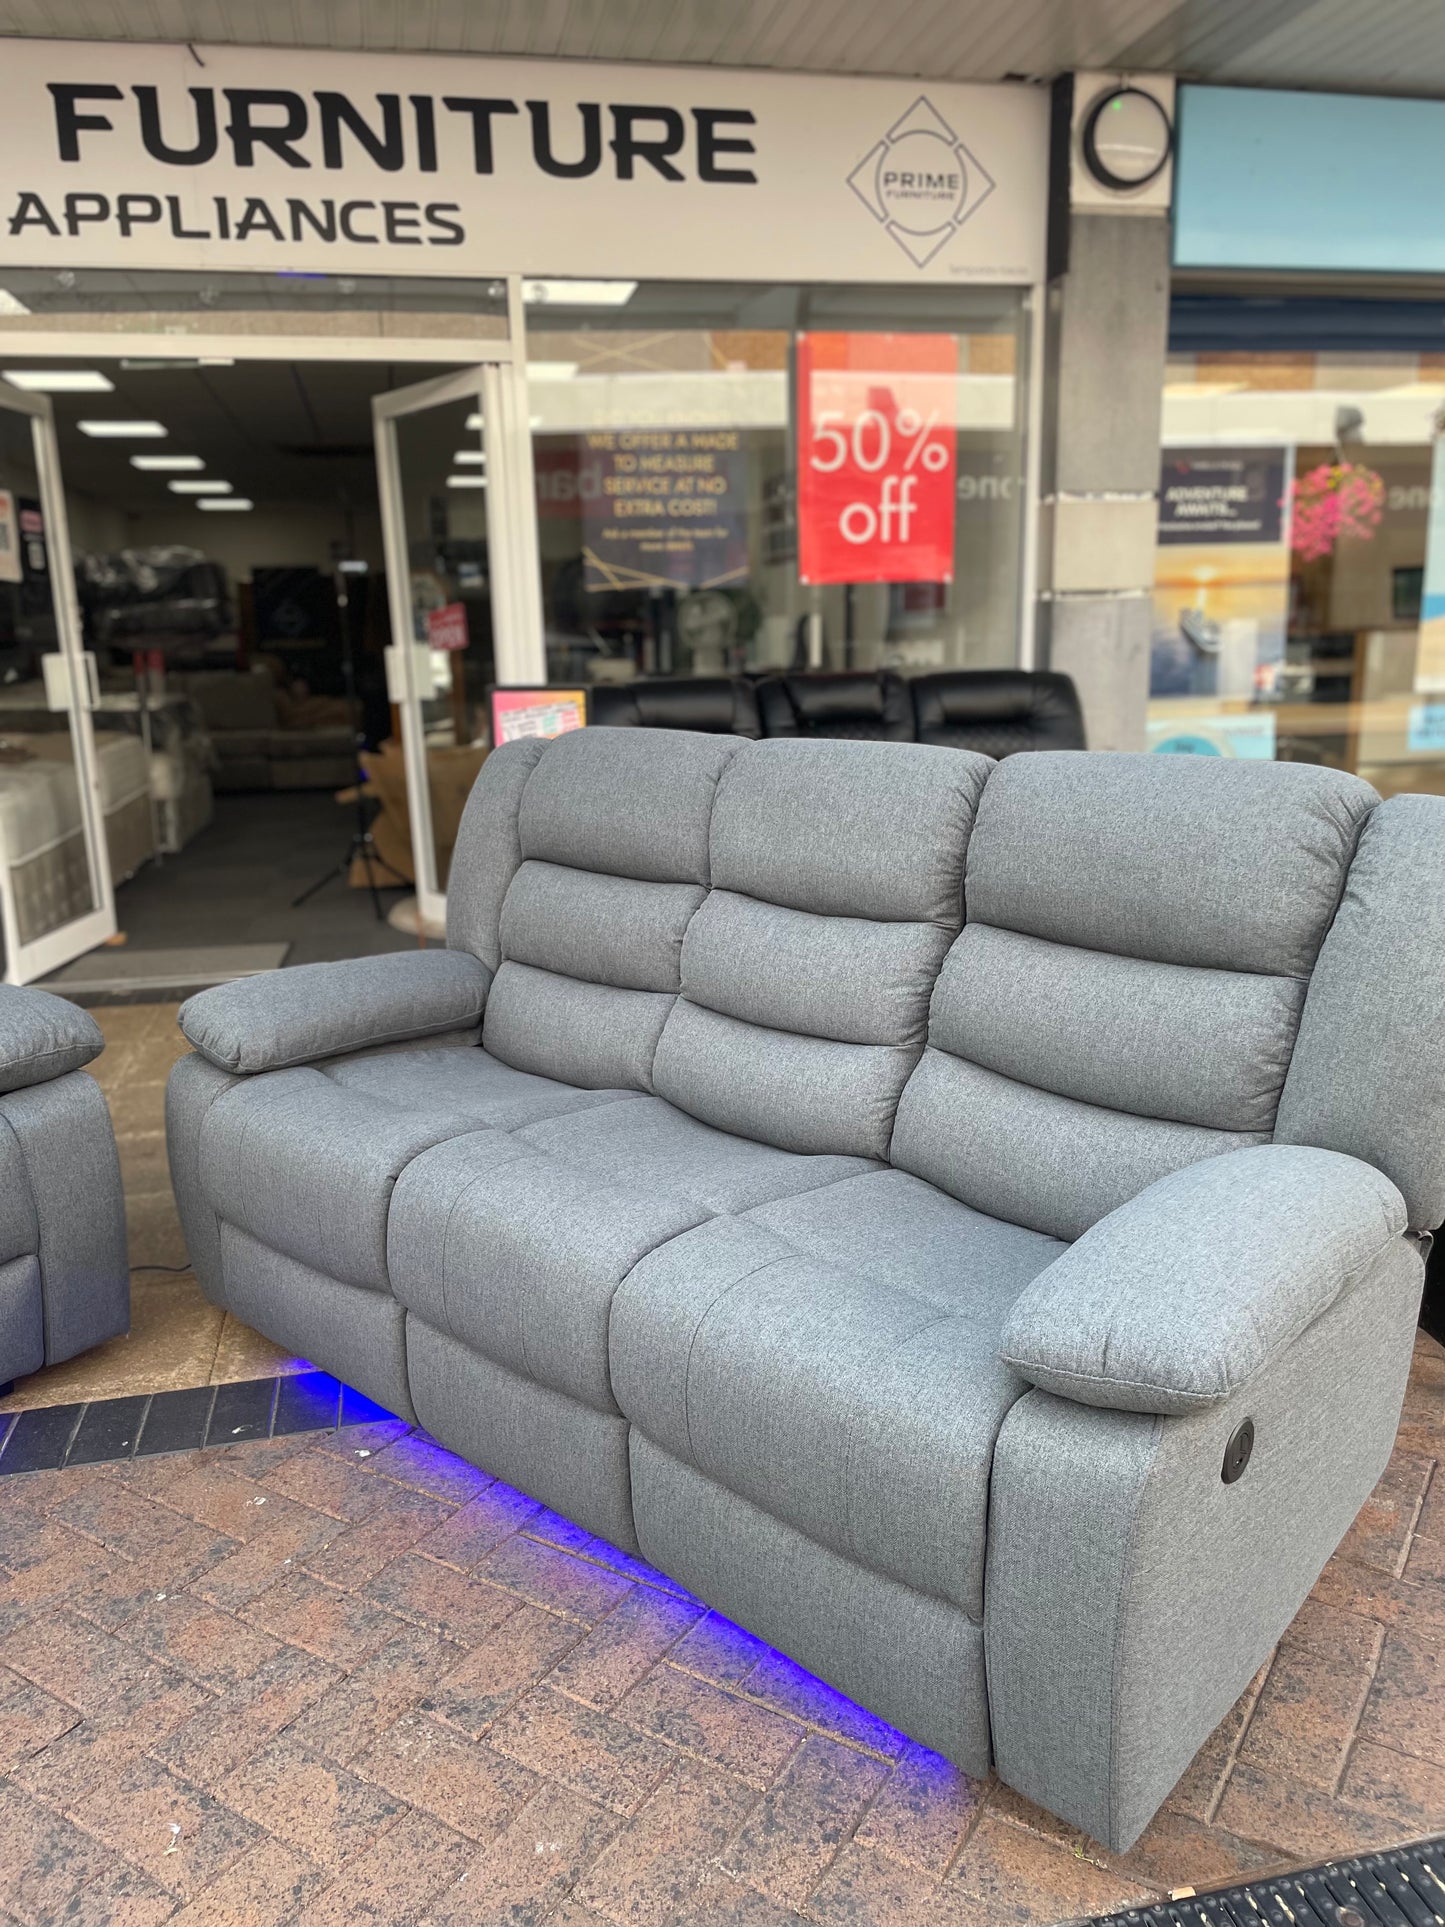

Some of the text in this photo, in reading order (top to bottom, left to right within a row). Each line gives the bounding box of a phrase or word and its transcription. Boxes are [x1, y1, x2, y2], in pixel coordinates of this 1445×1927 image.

[46, 82, 759, 184] FURNITURE
[883, 171, 960, 190] PRIME
[7, 191, 466, 245] APPLIANCES
[586, 432, 739, 449] WE OFFER A MADE
[810, 409, 950, 473] 50%
[612, 453, 715, 473] TO MEASURE
[603, 475, 728, 495] SERVICE AT NO
[613, 499, 665, 518] EXTRA
[838, 475, 918, 544] off
